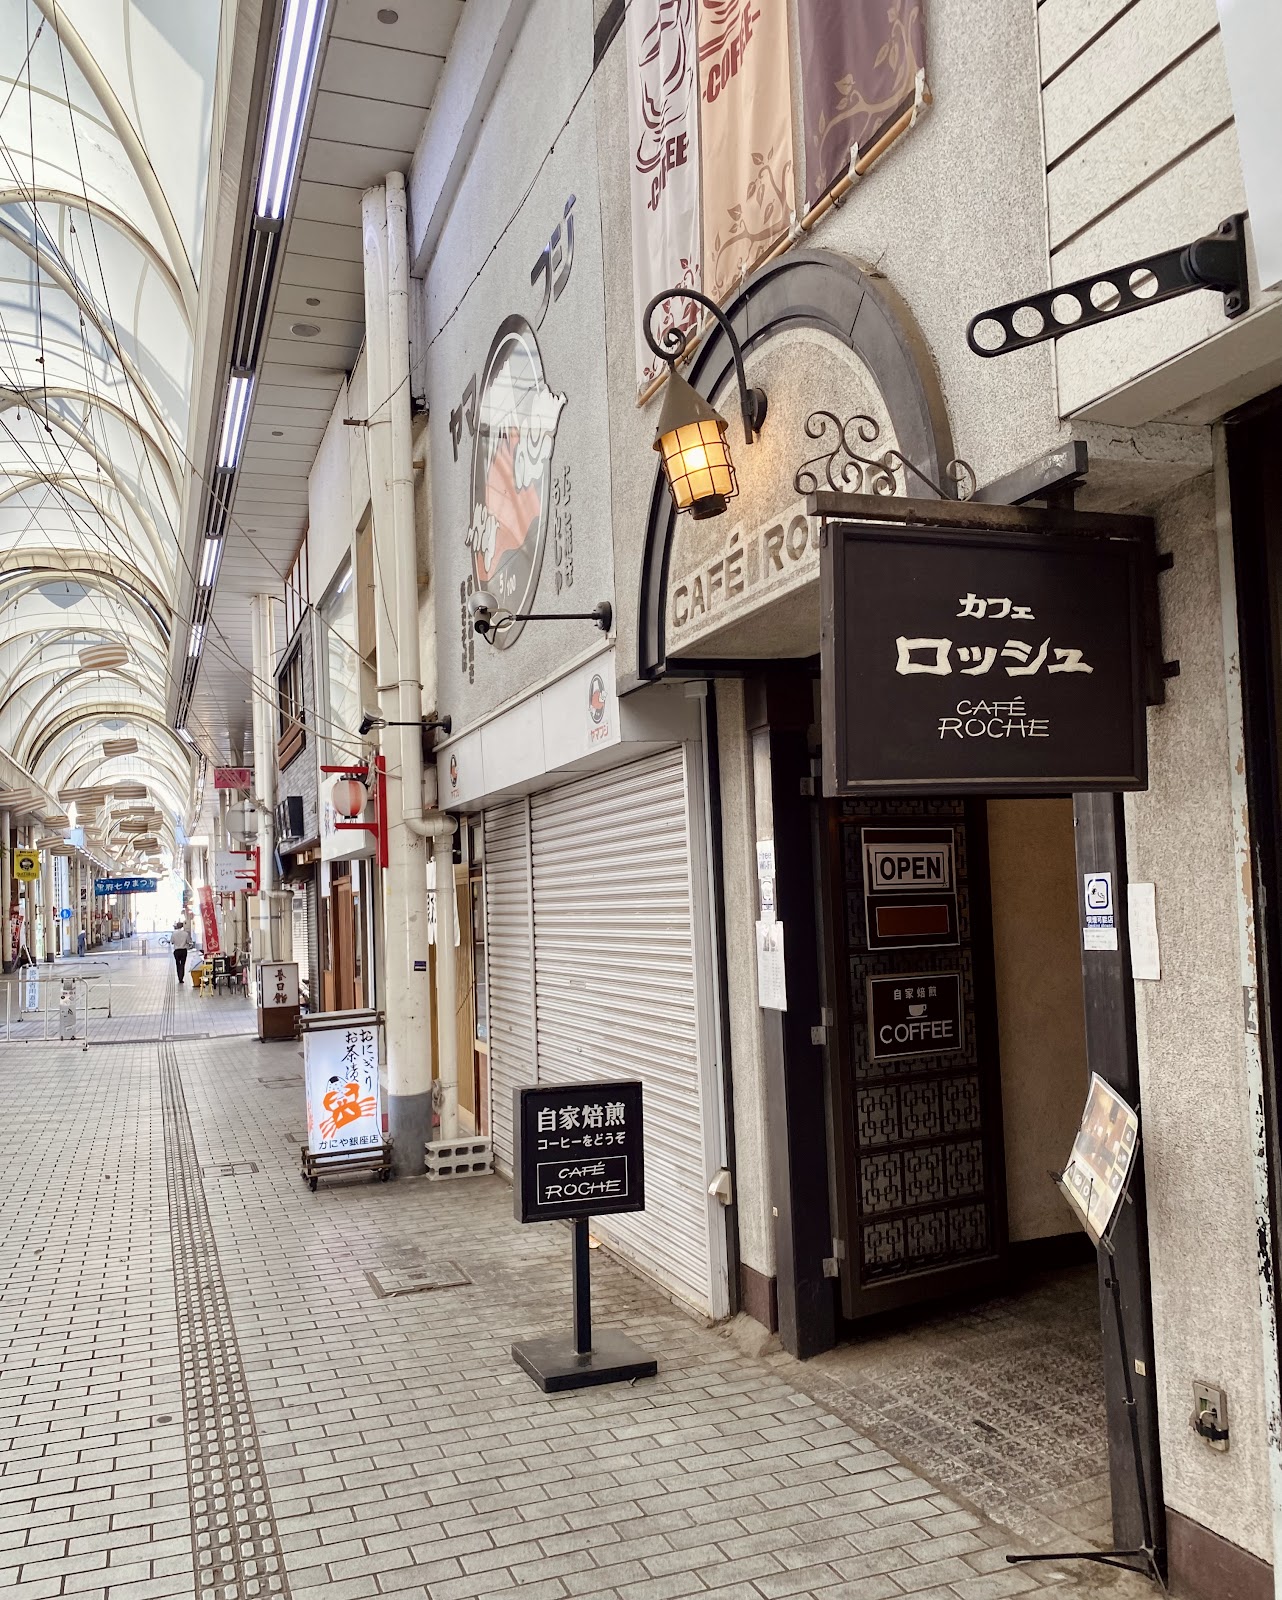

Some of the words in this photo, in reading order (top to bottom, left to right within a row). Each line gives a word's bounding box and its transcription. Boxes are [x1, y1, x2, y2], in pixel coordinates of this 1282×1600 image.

[672, 532, 744, 628] CAFÉ
[956, 592, 1035, 619] カフェ
[895, 636, 1094, 677] ロッシュ
[956, 696, 1027, 716] CAFÉ
[937, 717, 1050, 739] ROCHE
[880, 856, 941, 881] OPEN
[893, 986, 938, 1001] 自家焙煎
[879, 1019, 954, 1045] COFFEE
[359, 1029, 375, 1092] おにぎり
[537, 1101, 626, 1133] 自家焙煎
[319, 1134, 379, 1150] かにや銀座店
[537, 1131, 626, 1151] コーヒーをどうぞ
[558, 1161, 606, 1178] CAFÉ
[544, 1179, 622, 1200] ROCHE
